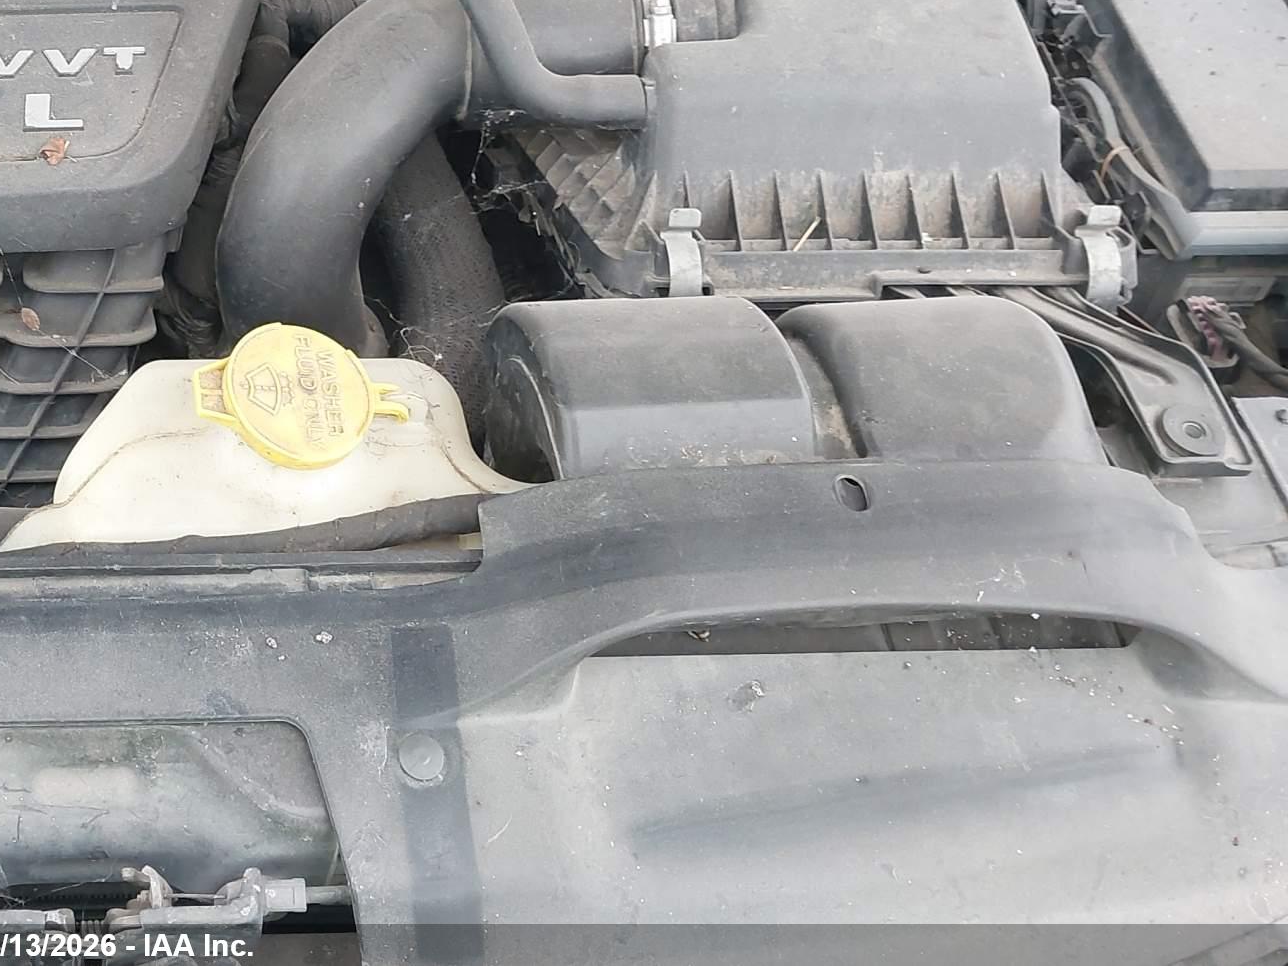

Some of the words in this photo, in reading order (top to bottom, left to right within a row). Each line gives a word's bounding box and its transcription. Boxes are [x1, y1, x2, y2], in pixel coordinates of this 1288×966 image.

[294, 335, 318, 397] FLUID
[316, 348, 345, 437] WASHER
[303, 397, 327, 452] ONLY
